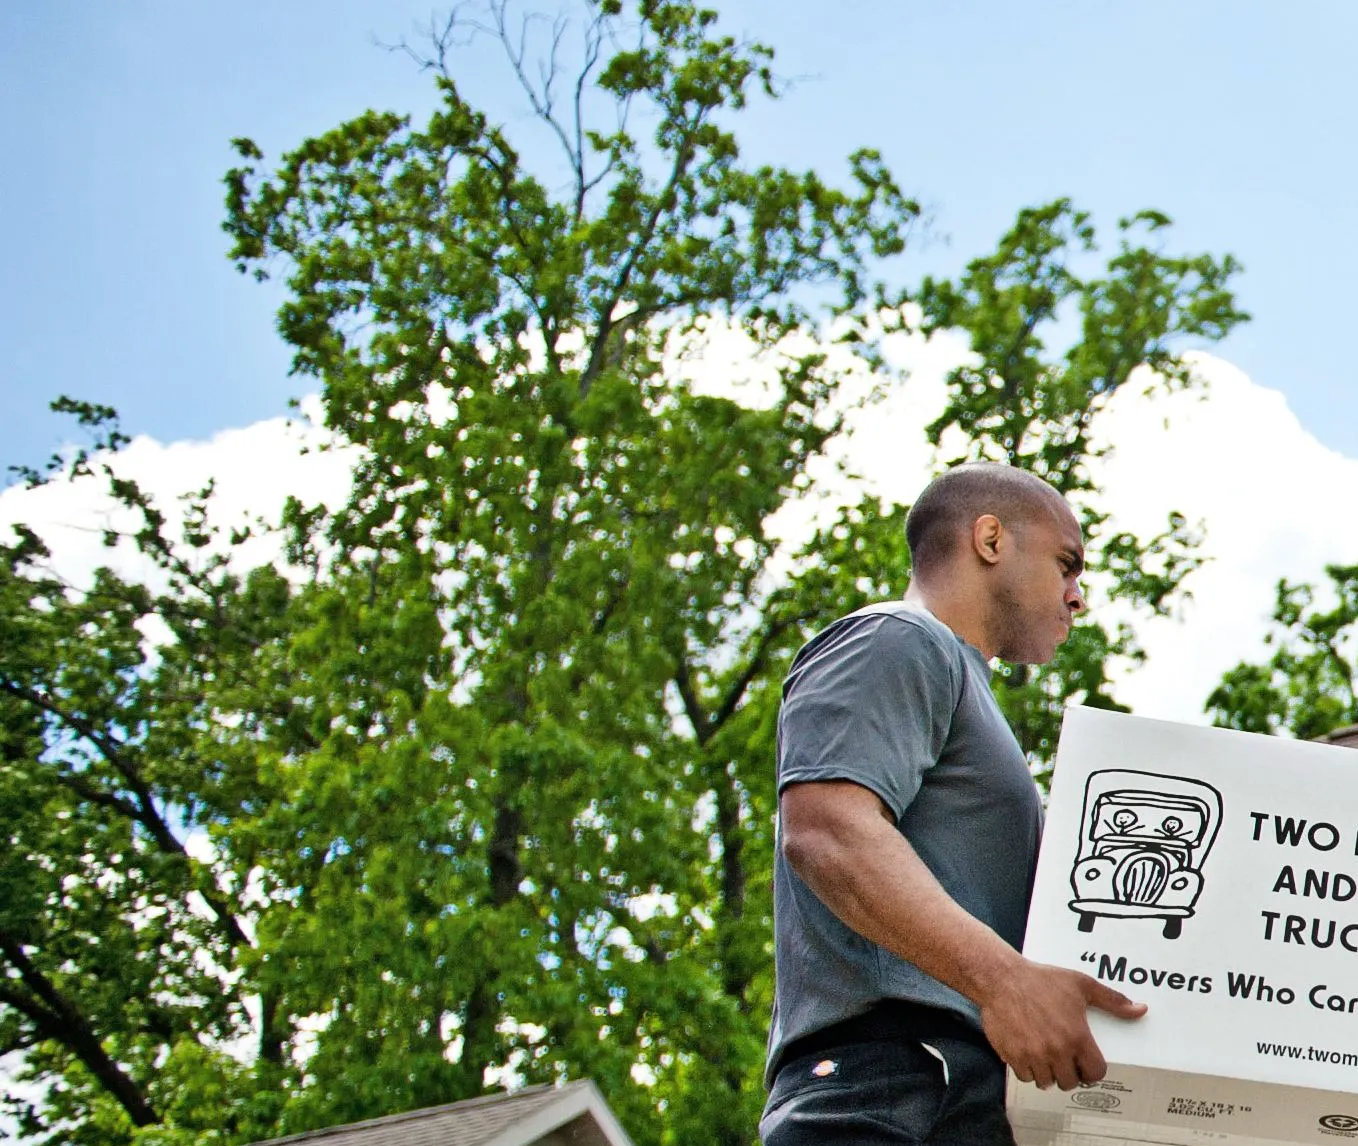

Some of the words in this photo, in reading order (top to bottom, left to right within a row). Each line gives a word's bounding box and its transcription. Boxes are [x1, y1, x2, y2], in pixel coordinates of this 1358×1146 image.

[1251, 812, 1339, 851] TWO
[1273, 866, 1356, 901] AND
[1228, 972, 1295, 1004] Who
[1167, 1107, 1215, 1118] MEDIUM
